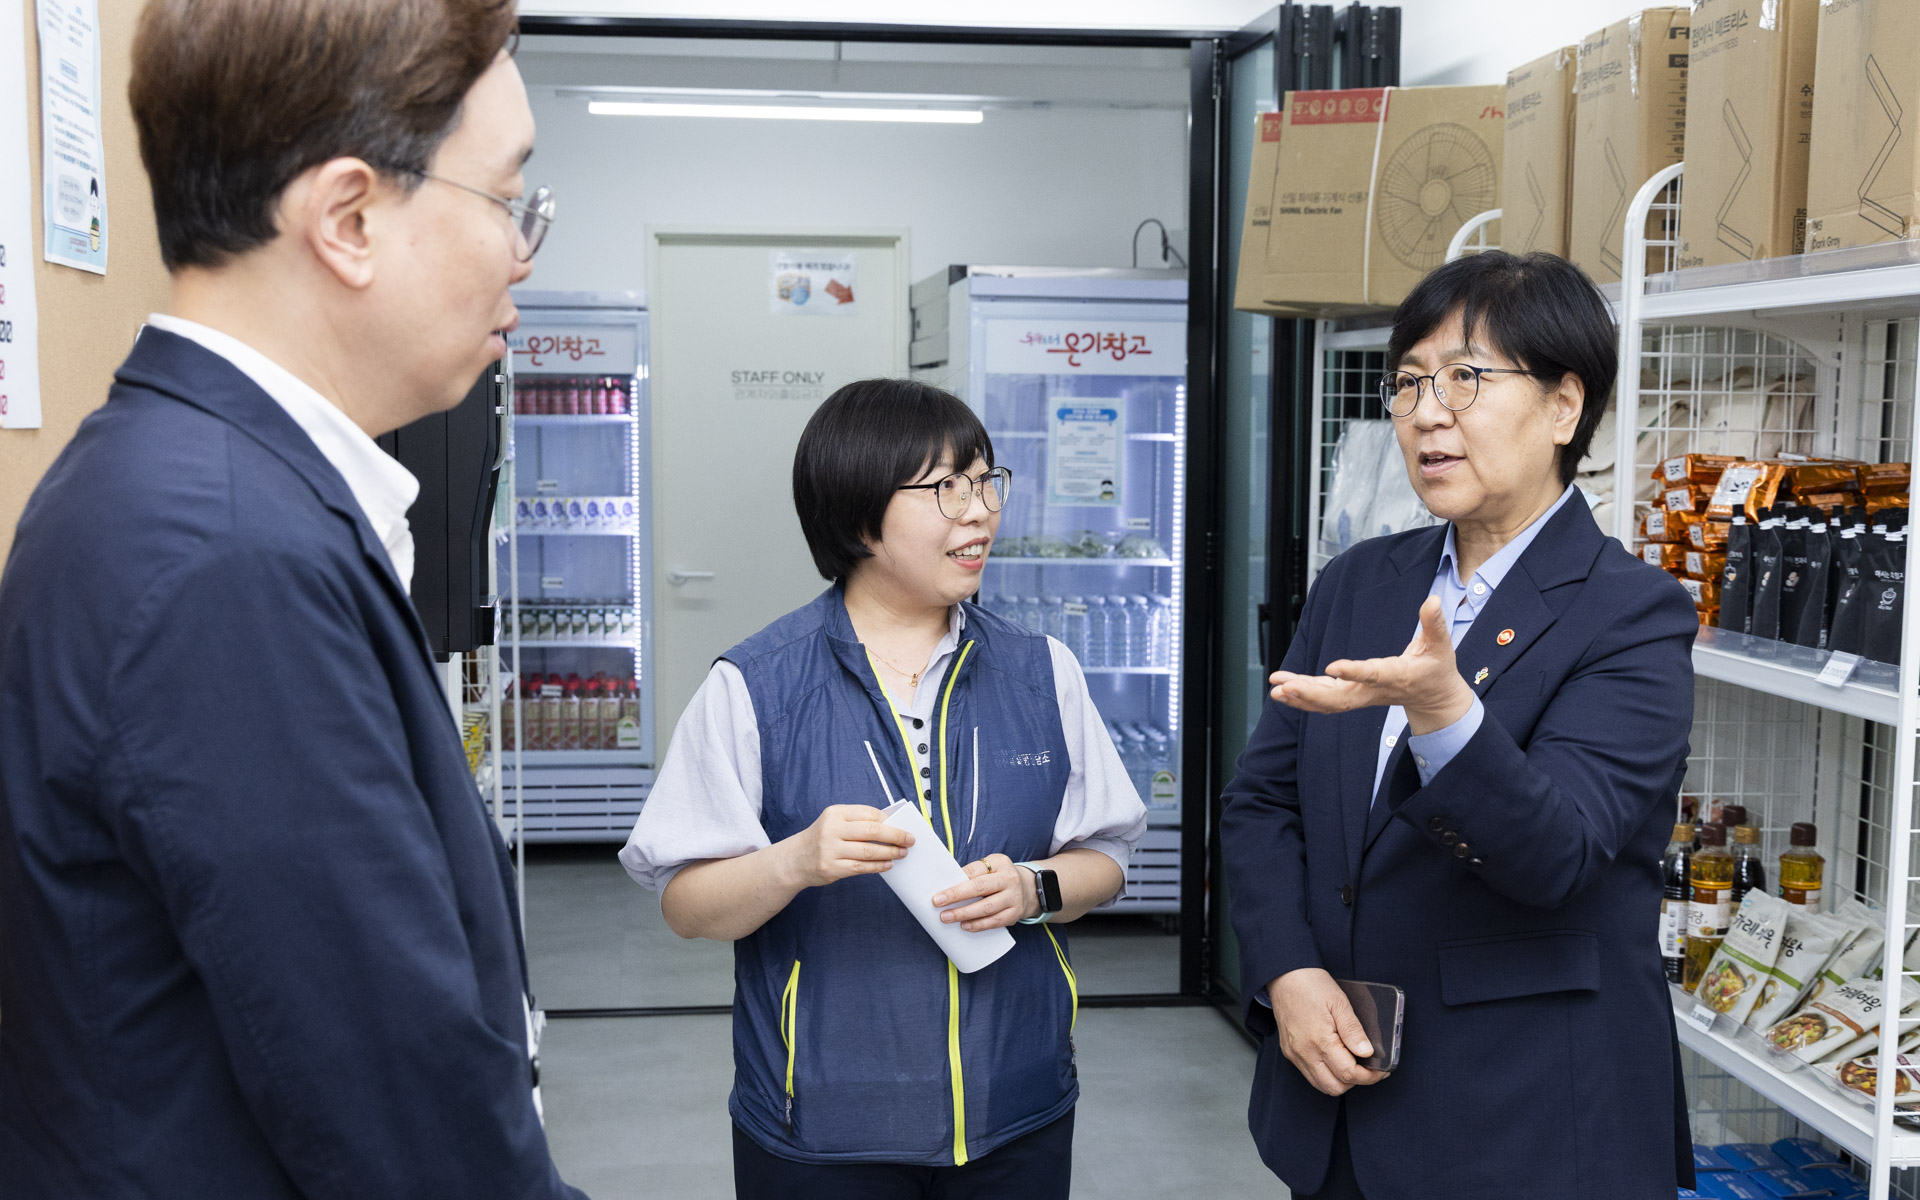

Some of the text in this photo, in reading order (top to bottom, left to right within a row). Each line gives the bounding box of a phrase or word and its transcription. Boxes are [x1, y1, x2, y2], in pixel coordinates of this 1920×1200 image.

[1714, 9, 1748, 37] 매트리스
[1304, 206, 1328, 215] Electric
[1330, 206, 1343, 215] Fan
[513, 336, 606, 366] 온기창고
[1046, 331, 1152, 367] 온기창고
[731, 370, 825, 384] STAFF ONLY
